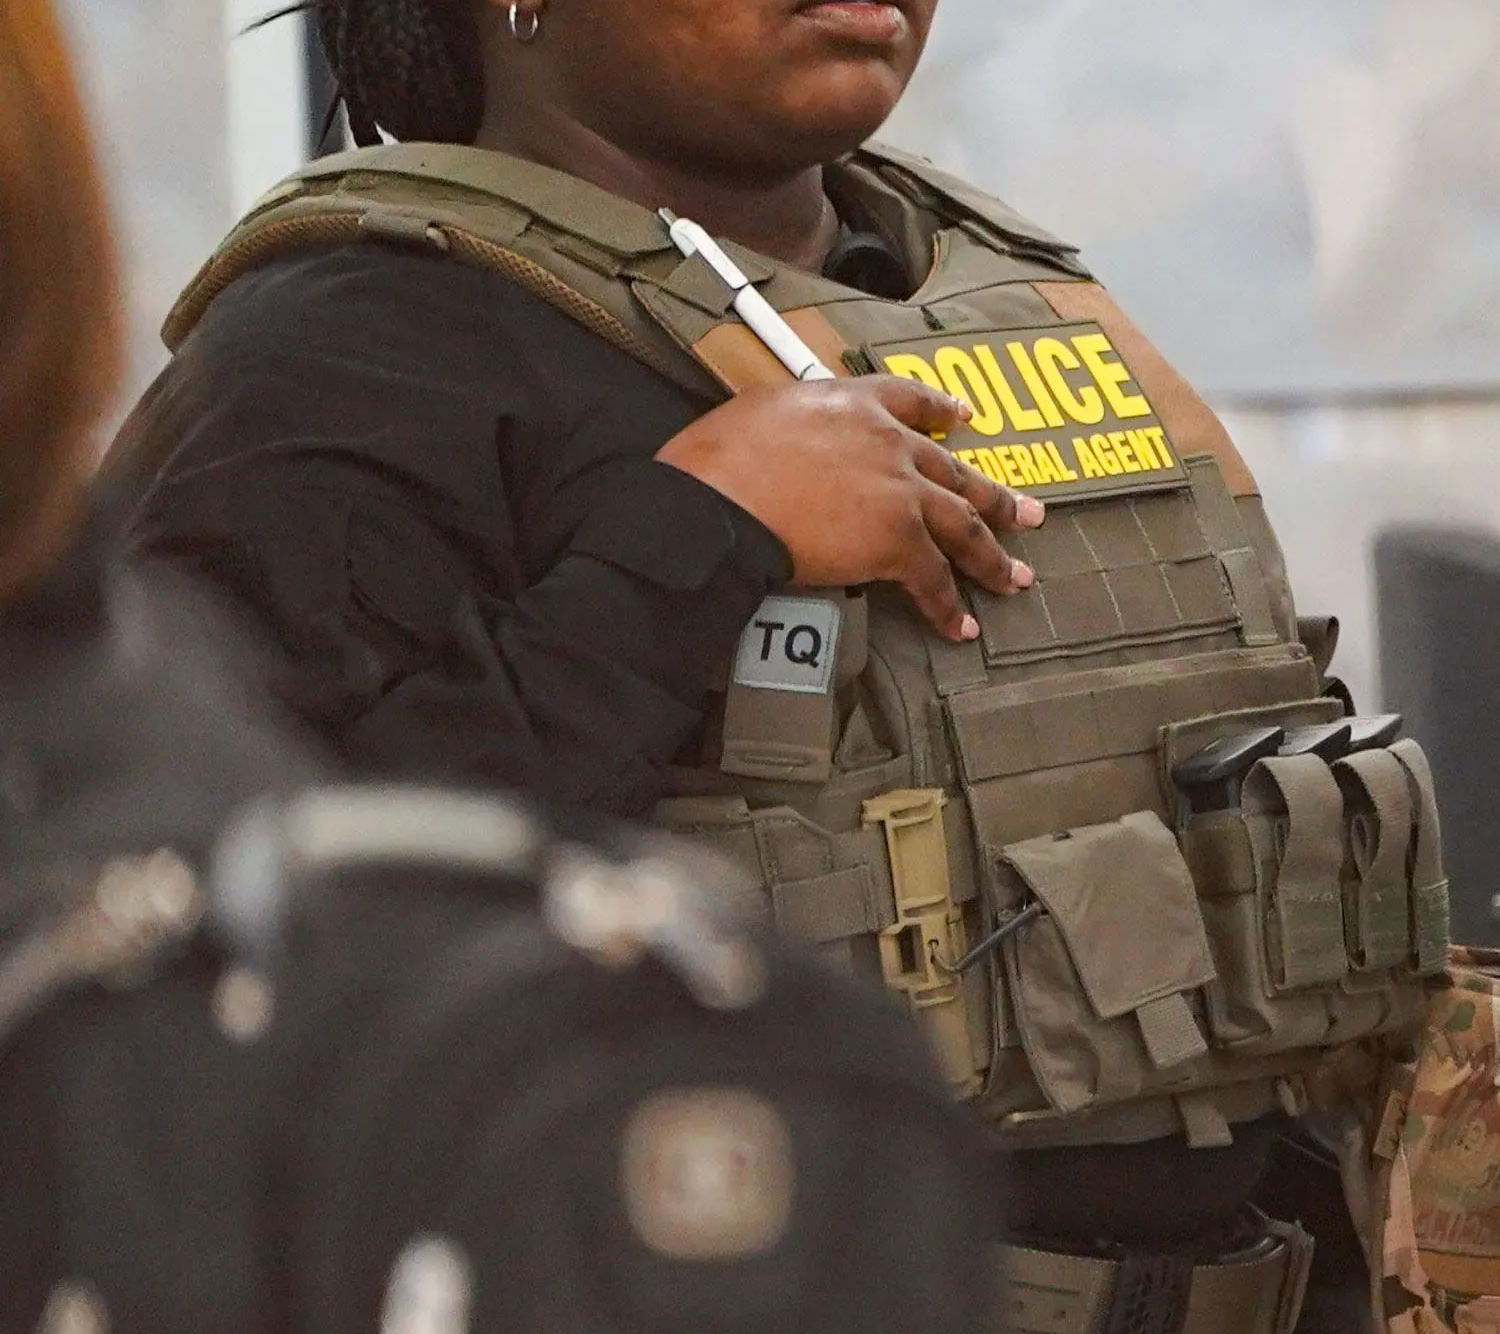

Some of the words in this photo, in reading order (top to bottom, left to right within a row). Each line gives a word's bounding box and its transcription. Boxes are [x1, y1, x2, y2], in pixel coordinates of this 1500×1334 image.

[884, 333, 1151, 440] POLICE
[951, 440, 1077, 487] EDERAL
[1072, 427, 1175, 478] AGENT
[755, 620, 822, 668] TQ
